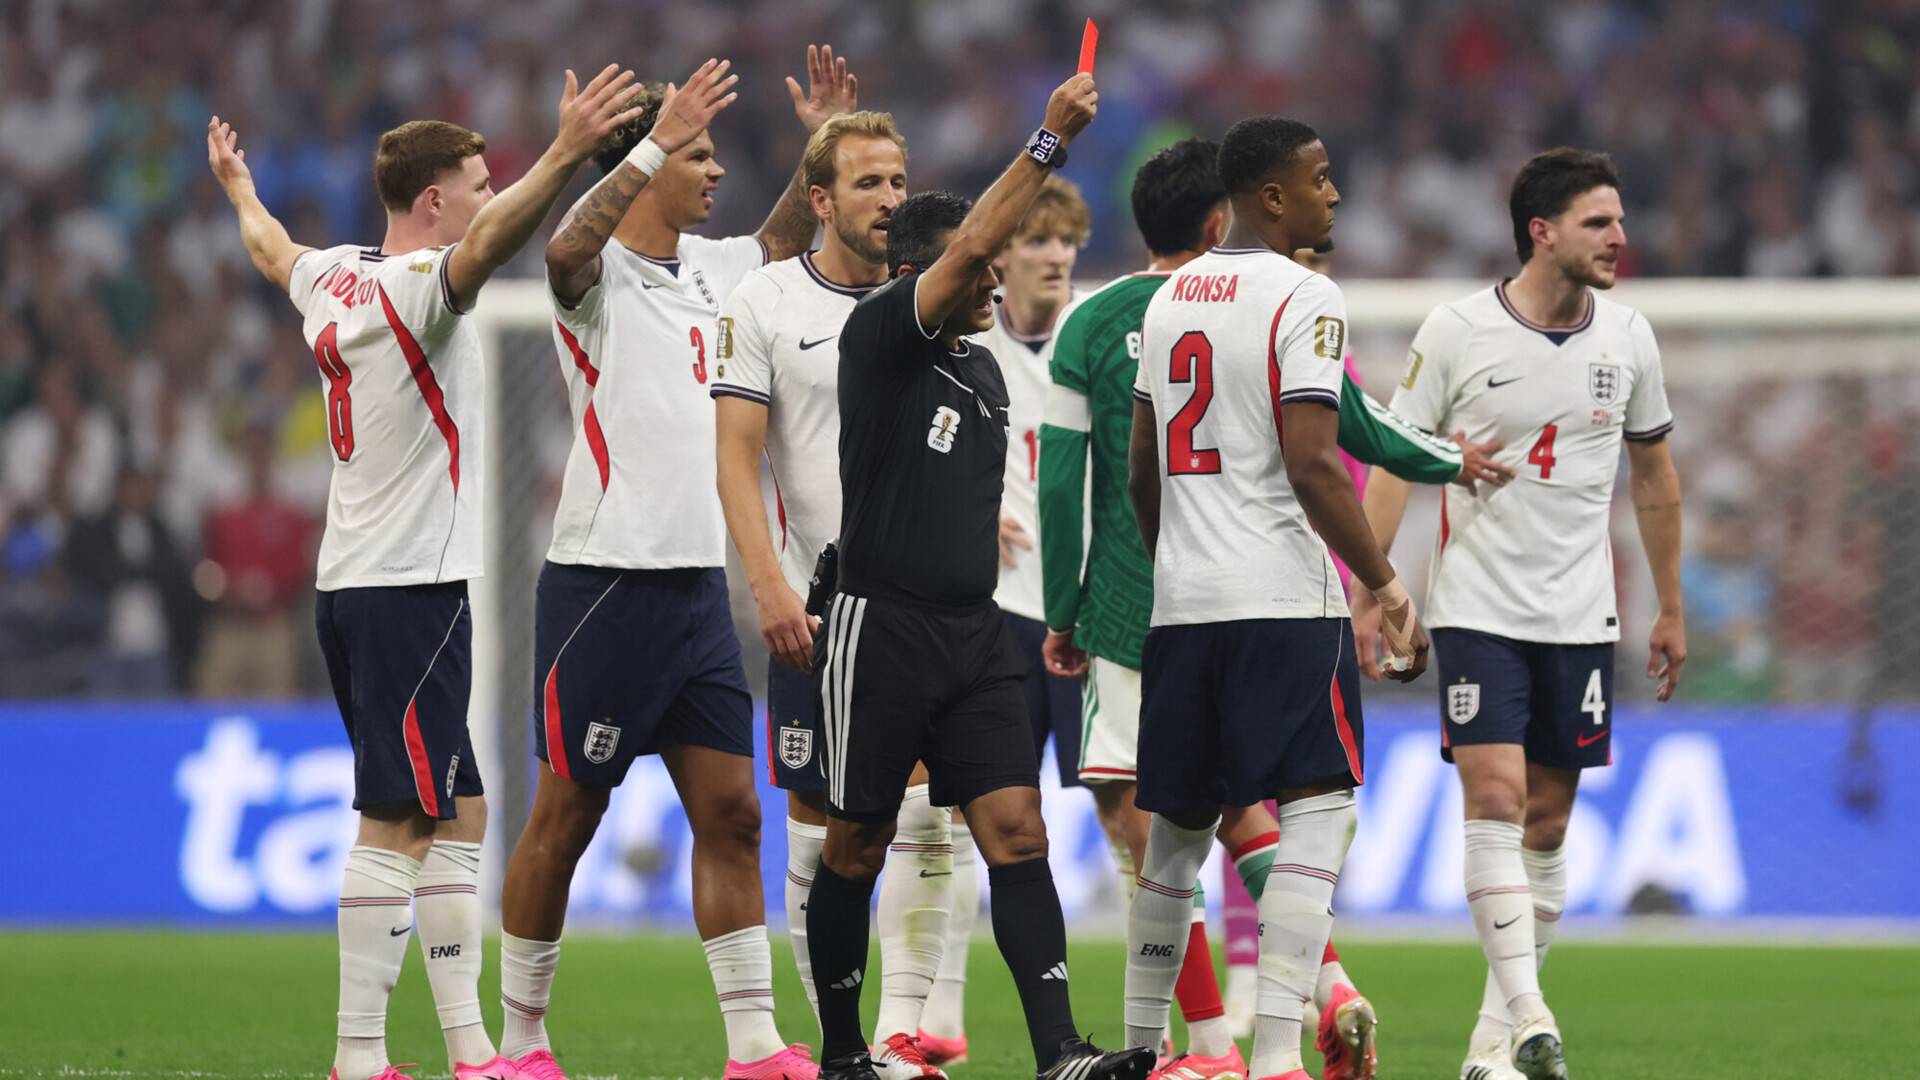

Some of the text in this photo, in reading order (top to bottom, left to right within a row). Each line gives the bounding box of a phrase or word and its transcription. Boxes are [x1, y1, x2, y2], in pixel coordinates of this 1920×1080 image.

[1172, 275, 1239, 303] KONSA
[690, 326, 707, 384] 3
[315, 321, 355, 462] 8
[1166, 330, 1222, 476] 2
[1528, 424, 1558, 479] 4
[1581, 668, 1606, 725] 4
[430, 944, 461, 960] ENG
[1140, 943, 1175, 957] ENG
